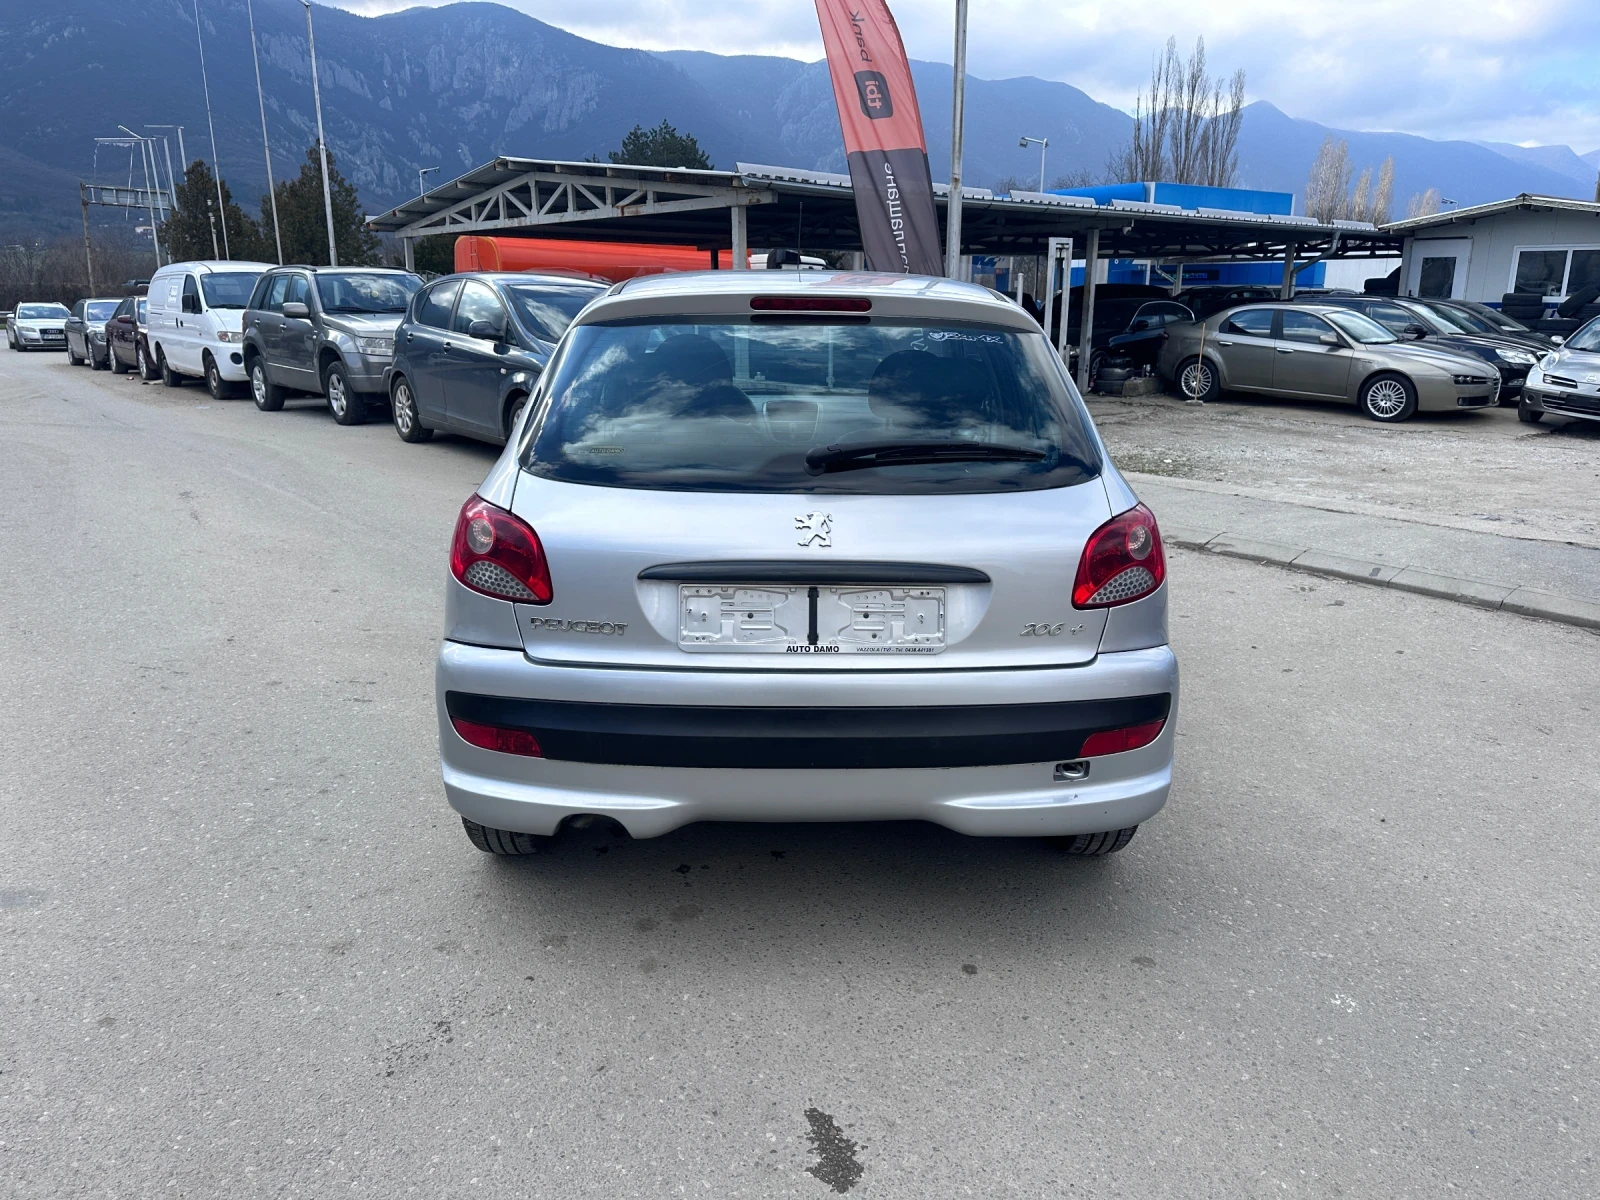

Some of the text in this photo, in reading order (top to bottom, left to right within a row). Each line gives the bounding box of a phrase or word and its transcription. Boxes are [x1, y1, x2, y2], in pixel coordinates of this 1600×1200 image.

[530, 616, 628, 636] PEUGEOT
[1019, 622, 1065, 636] 206
[786, 645, 840, 653] AUTO DAMO
